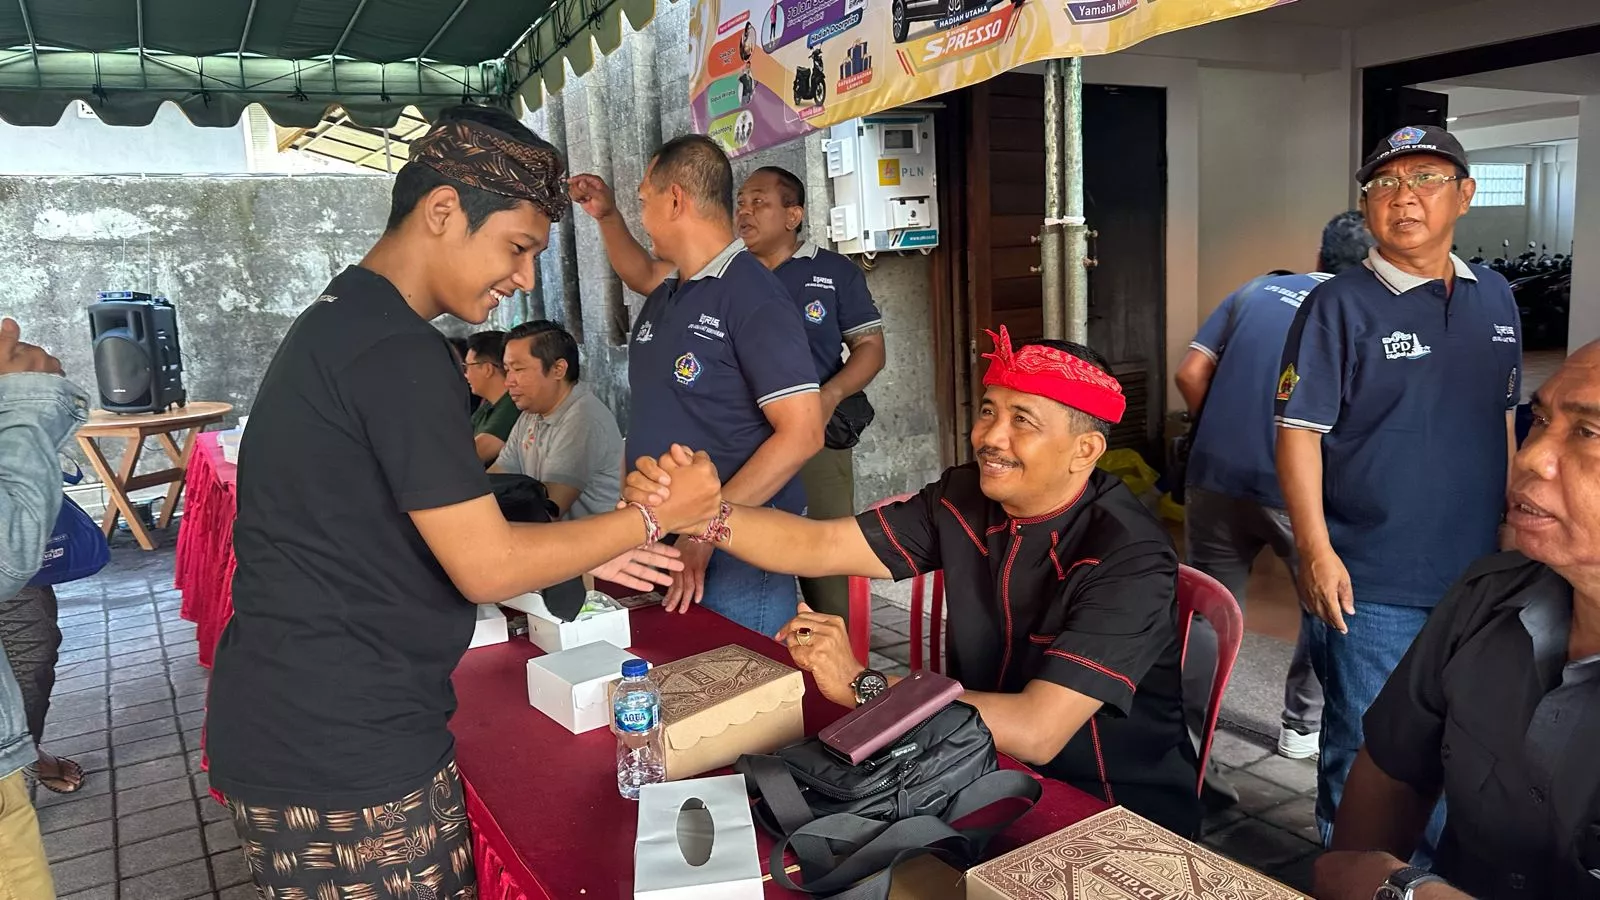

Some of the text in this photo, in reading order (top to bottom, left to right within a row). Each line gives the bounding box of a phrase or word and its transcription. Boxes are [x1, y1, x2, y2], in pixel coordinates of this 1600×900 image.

[939, 5, 988, 27] HADIAH UTAMA
[1079, 3, 1116, 16] Yamaha
[902, 167, 924, 177] PLN
[1384, 341, 1411, 355] LPD
[623, 712, 646, 723] AQUA
[1102, 864, 1161, 899] D'dita
